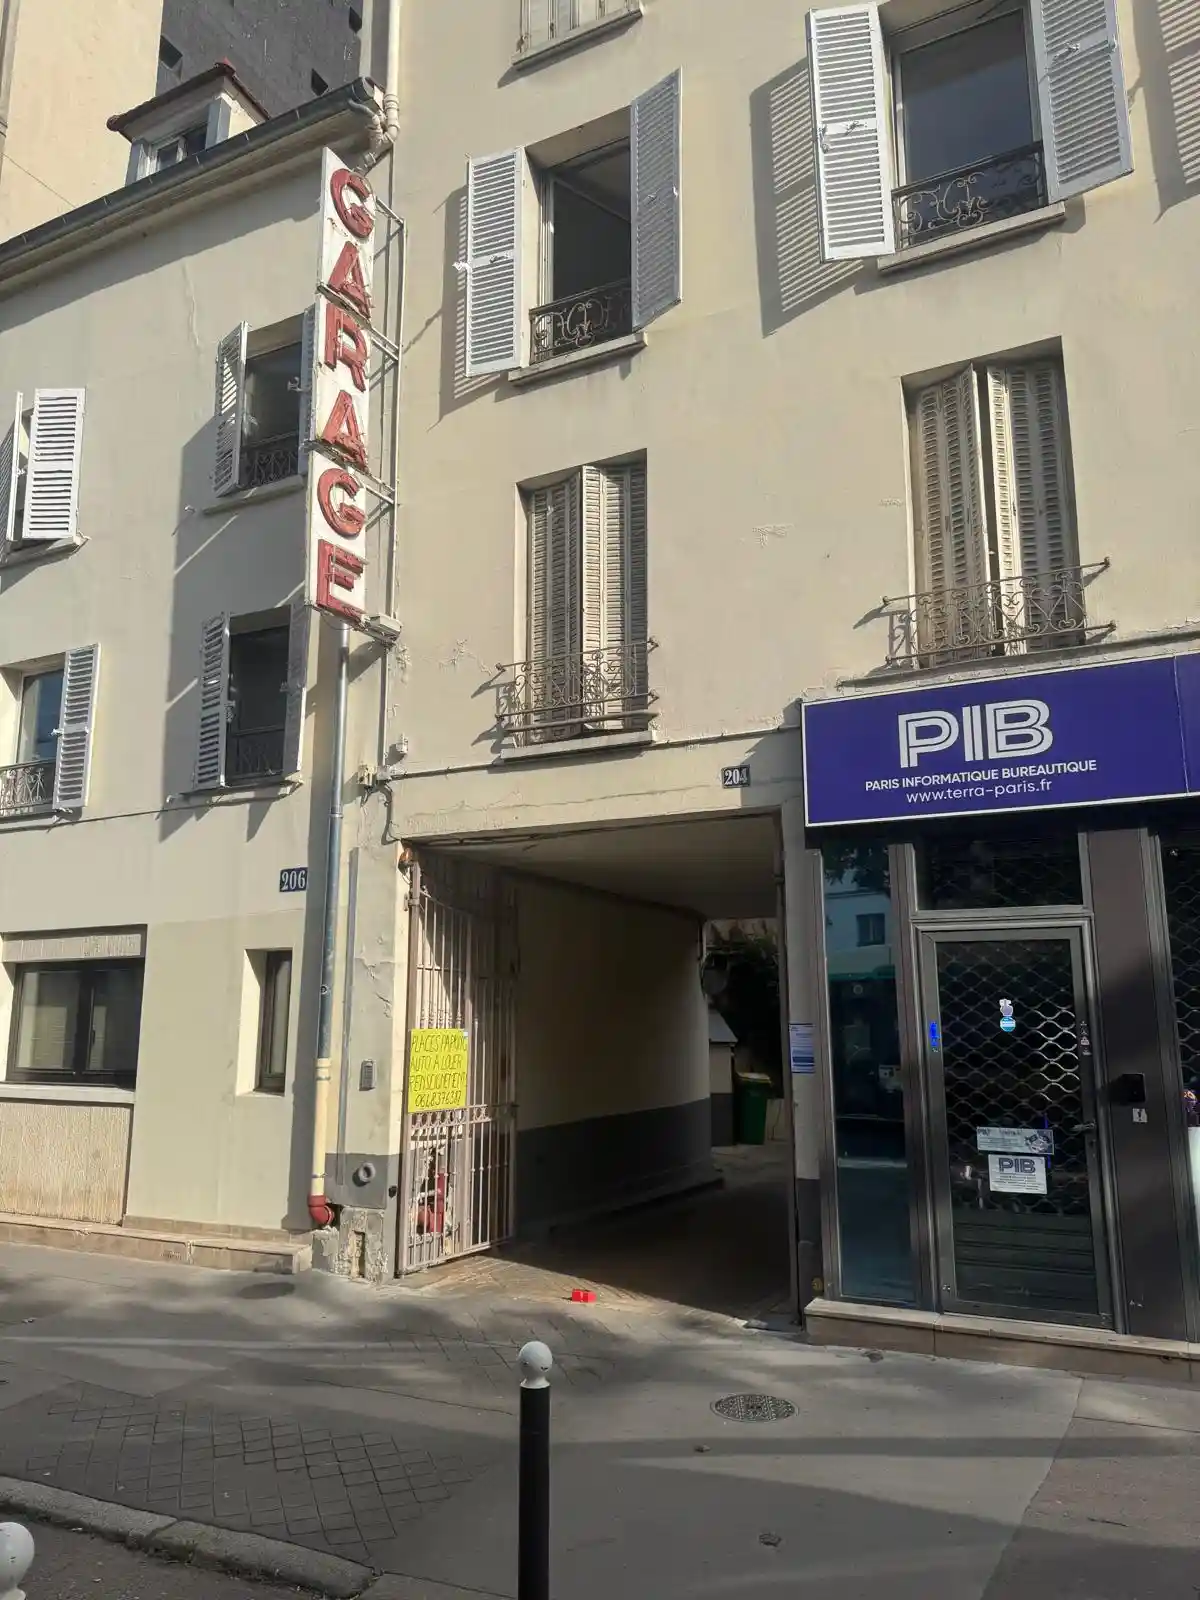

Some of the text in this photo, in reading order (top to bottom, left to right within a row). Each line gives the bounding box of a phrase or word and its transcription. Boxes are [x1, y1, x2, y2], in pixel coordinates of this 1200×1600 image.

[316, 168, 375, 626] GARAGE
[897, 699, 1054, 769] PIB
[724, 768, 748, 785] 204
[865, 760, 1097, 792] PARIS INFORMATIQUE BUREAUTIQUE
[906, 779, 1053, 803] www.terra-paris.fr
[281, 870, 306, 891] 206
[998, 1157, 1037, 1174] PIB
